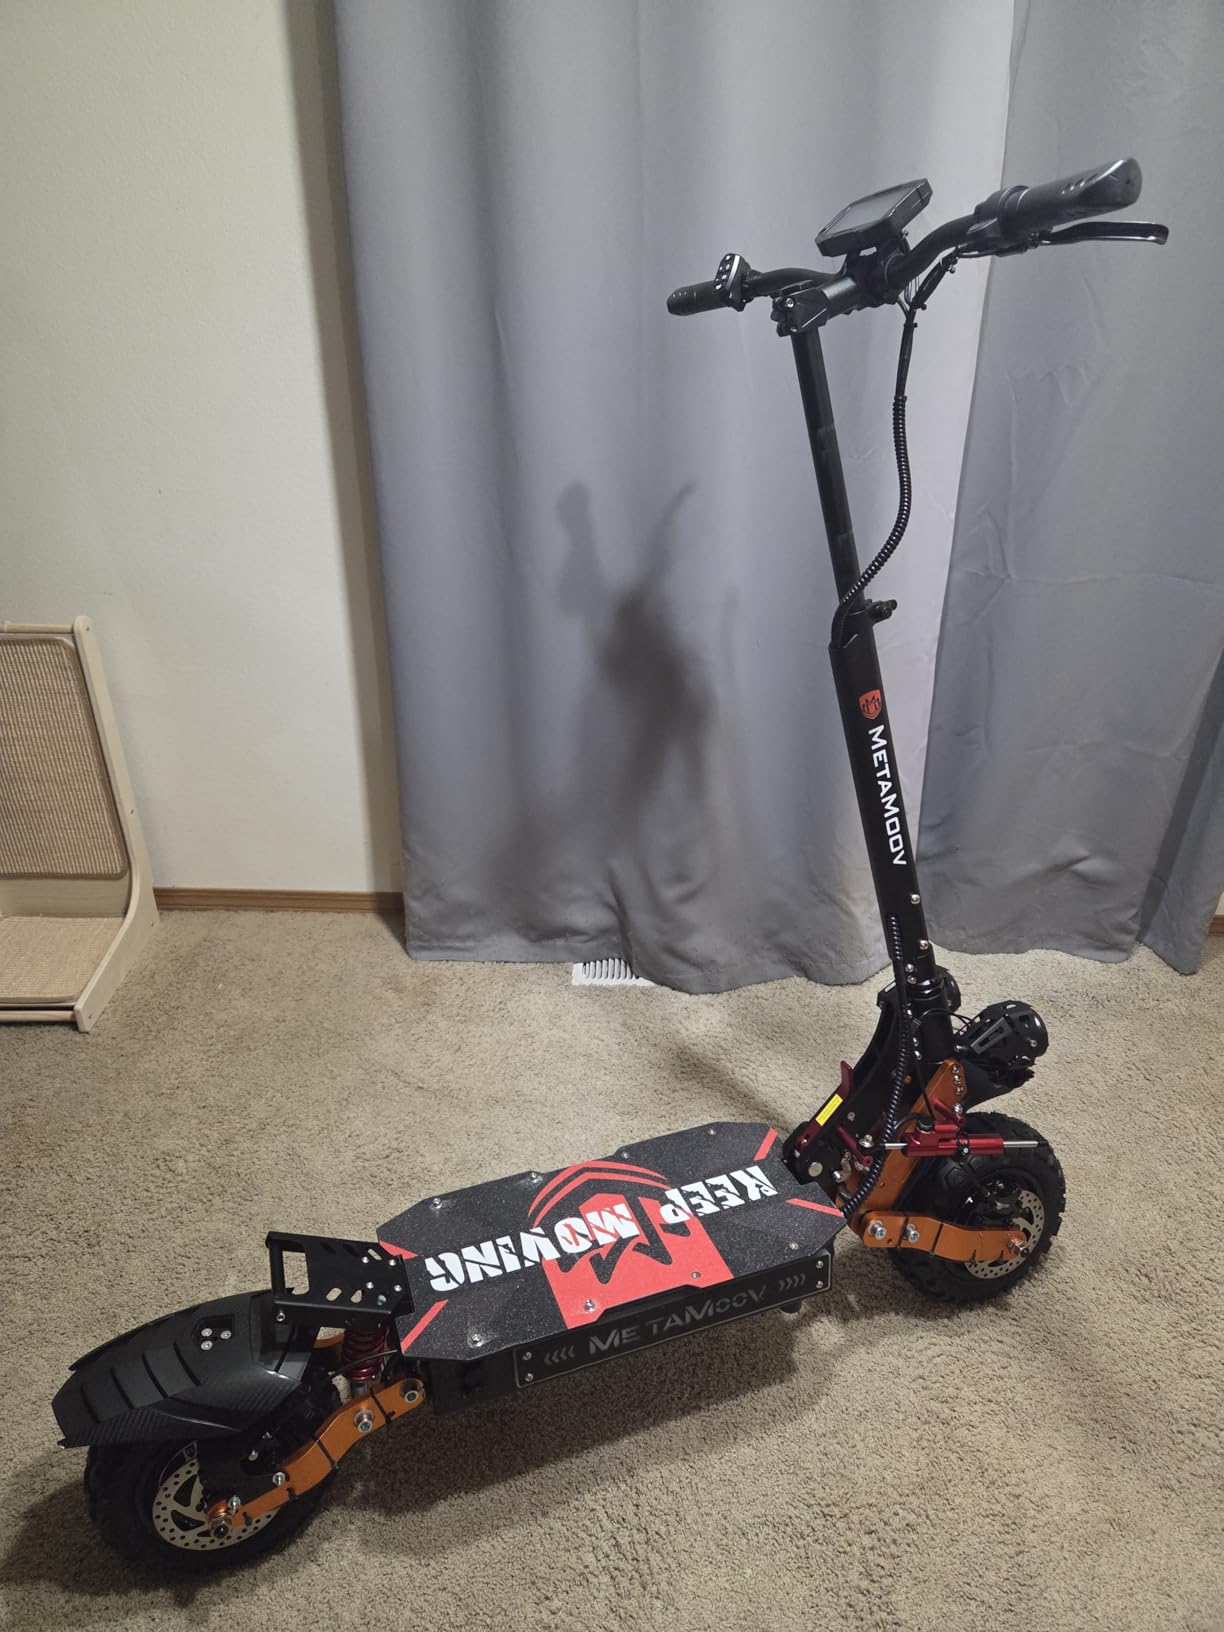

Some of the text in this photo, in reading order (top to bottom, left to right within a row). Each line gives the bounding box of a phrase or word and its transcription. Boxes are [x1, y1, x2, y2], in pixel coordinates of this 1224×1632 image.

[868, 724, 907, 865] METAMOOV
[424, 1165, 778, 1292] KEEP MOVING
